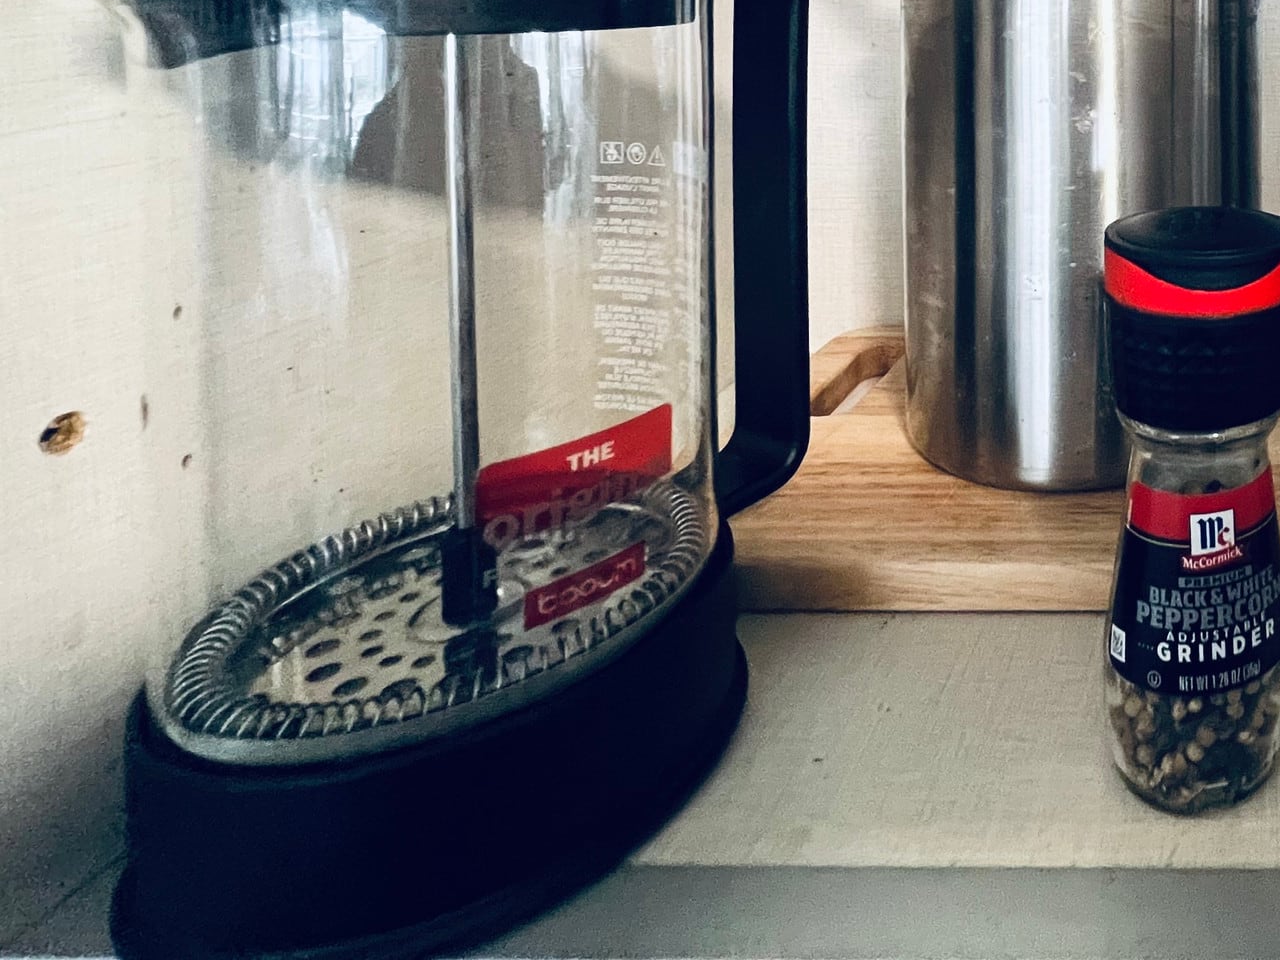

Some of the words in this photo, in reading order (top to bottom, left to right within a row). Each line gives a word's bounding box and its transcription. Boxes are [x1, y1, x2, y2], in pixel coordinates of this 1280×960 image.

[566, 440, 615, 471] THE
[1181, 544, 1243, 570] McCormick
[1136, 573, 1280, 632] PEPPERCORN
[1149, 585, 1207, 608] BLACK
[1210, 588, 1223, 606] &
[1226, 565, 1273, 601] WHITE
[1157, 618, 1275, 663] GRINDER
[1166, 611, 1266, 644] ADJUSTABLE
